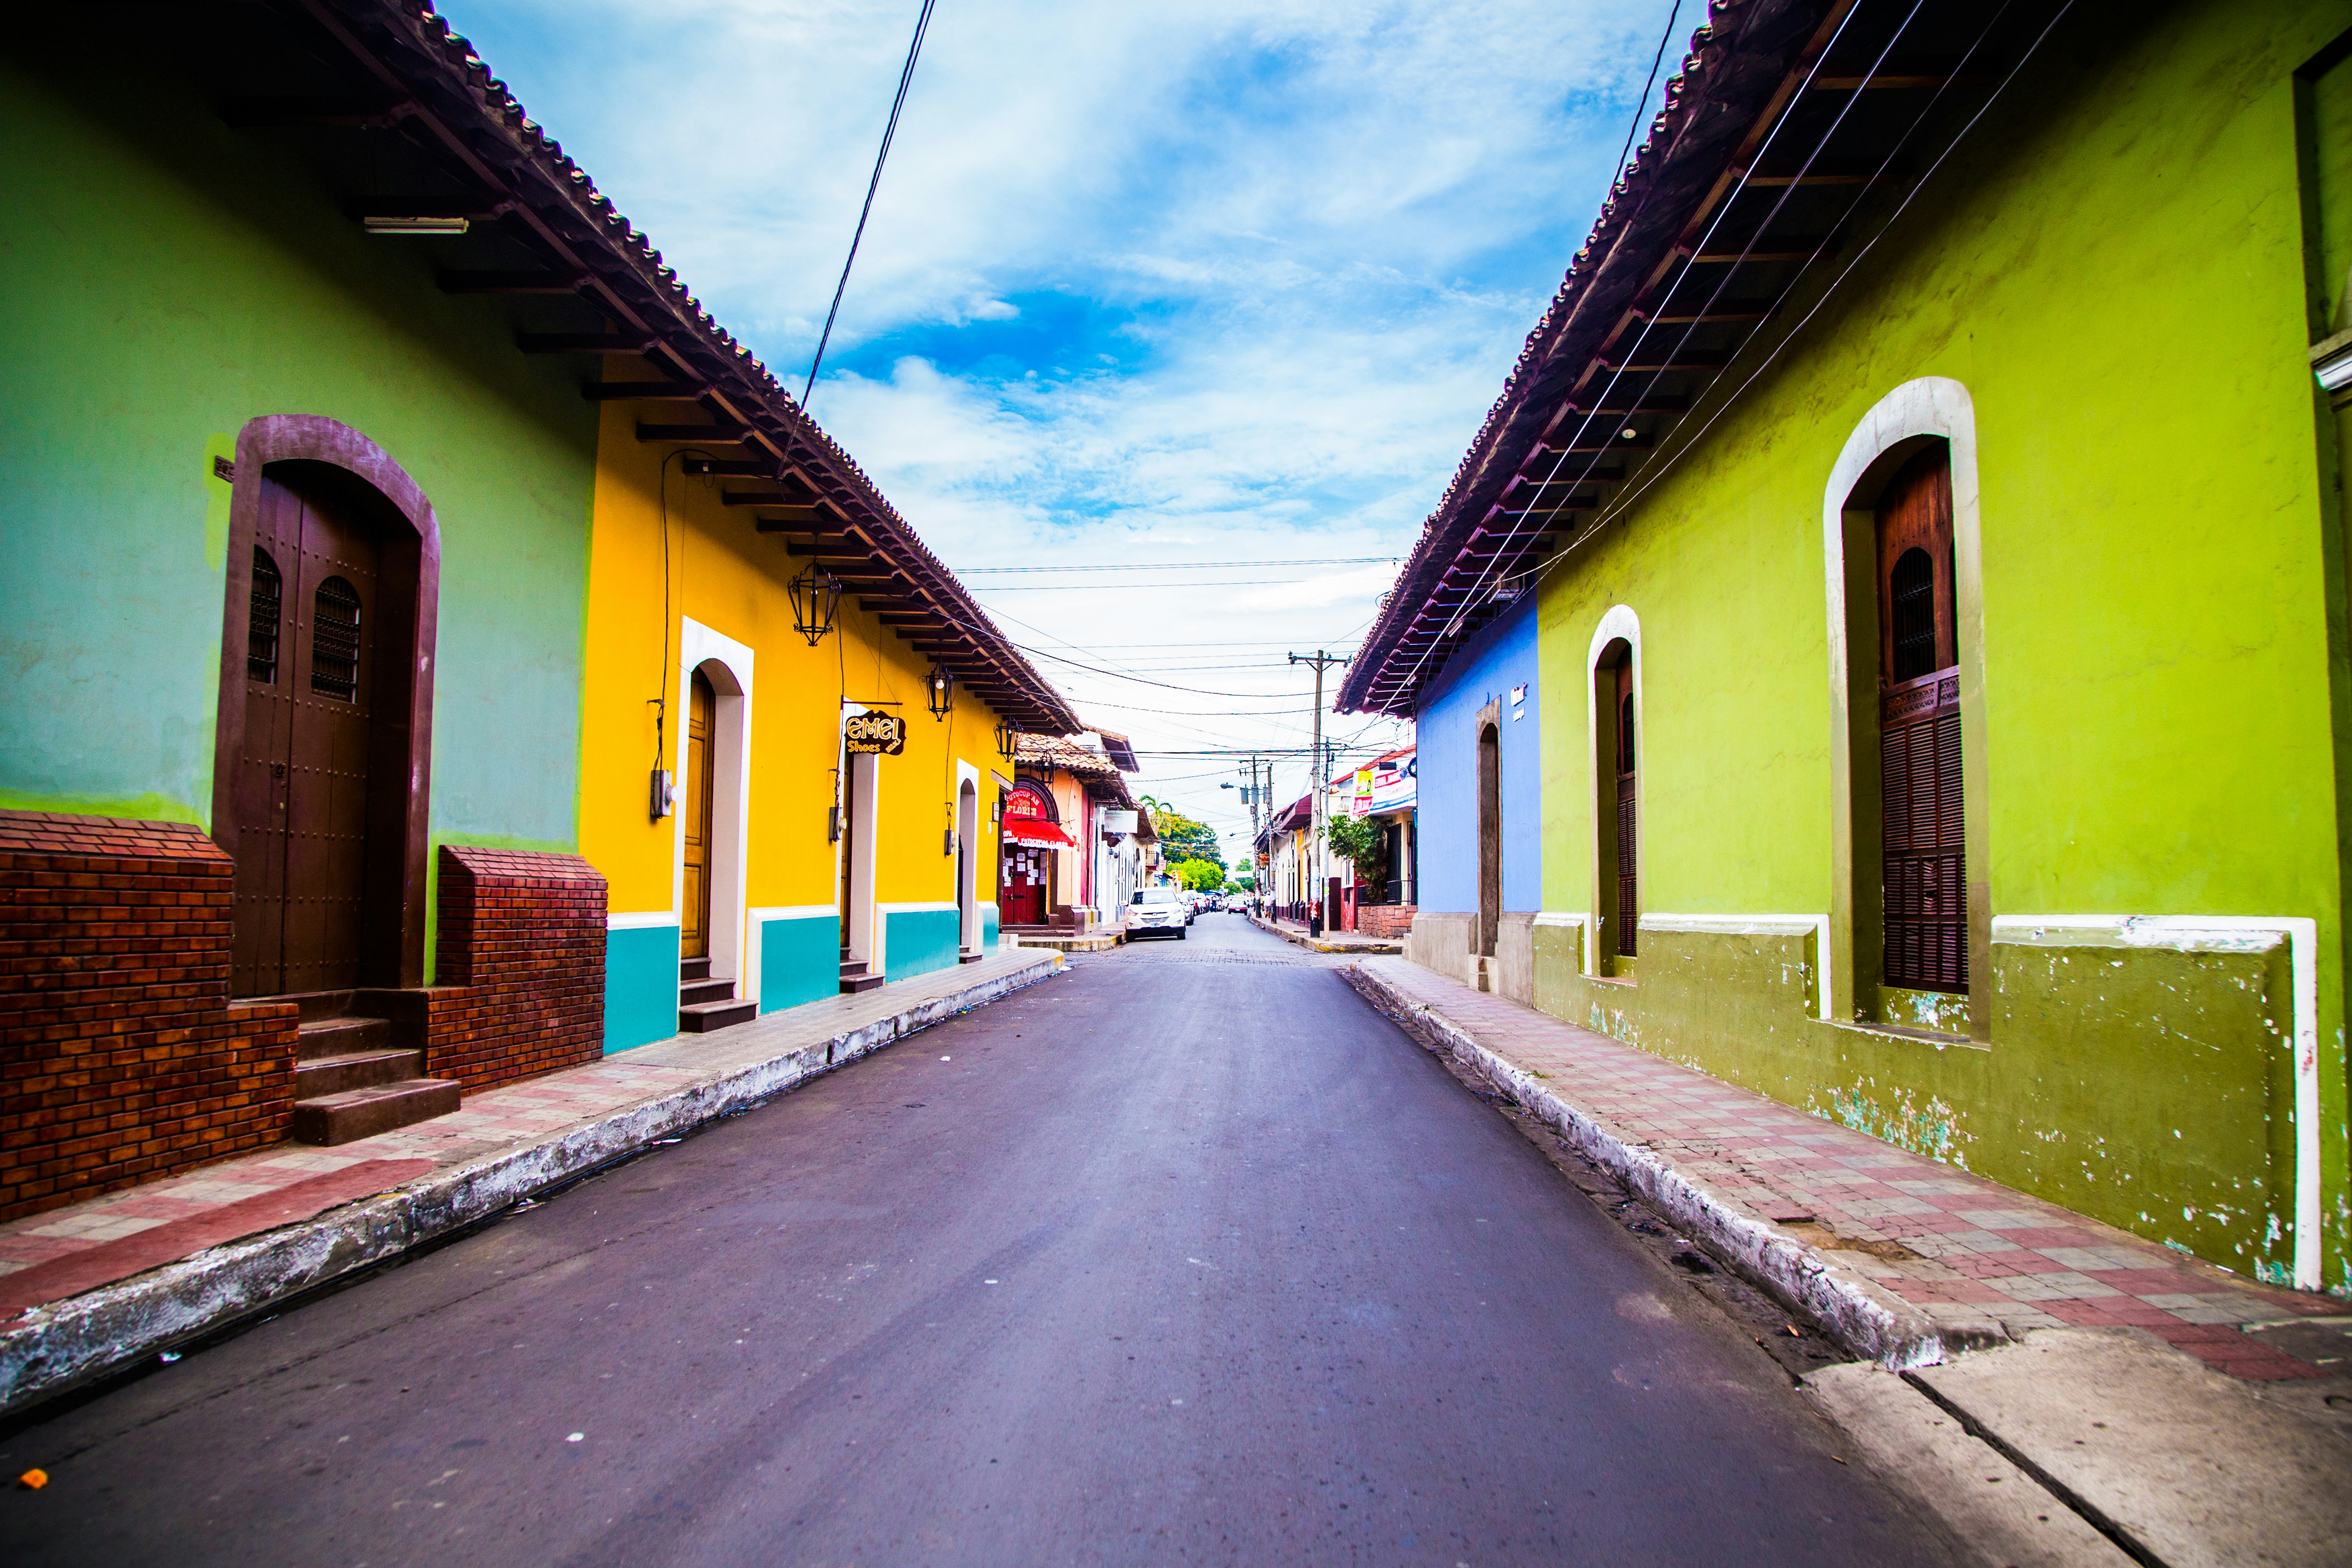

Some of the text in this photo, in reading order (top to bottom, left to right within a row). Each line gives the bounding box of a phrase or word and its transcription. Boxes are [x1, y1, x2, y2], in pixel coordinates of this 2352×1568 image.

[847, 740, 880, 752] Shoes
[1007, 790, 1039, 806] OTOCOPAS
[1006, 805, 1036, 816] FLORES
